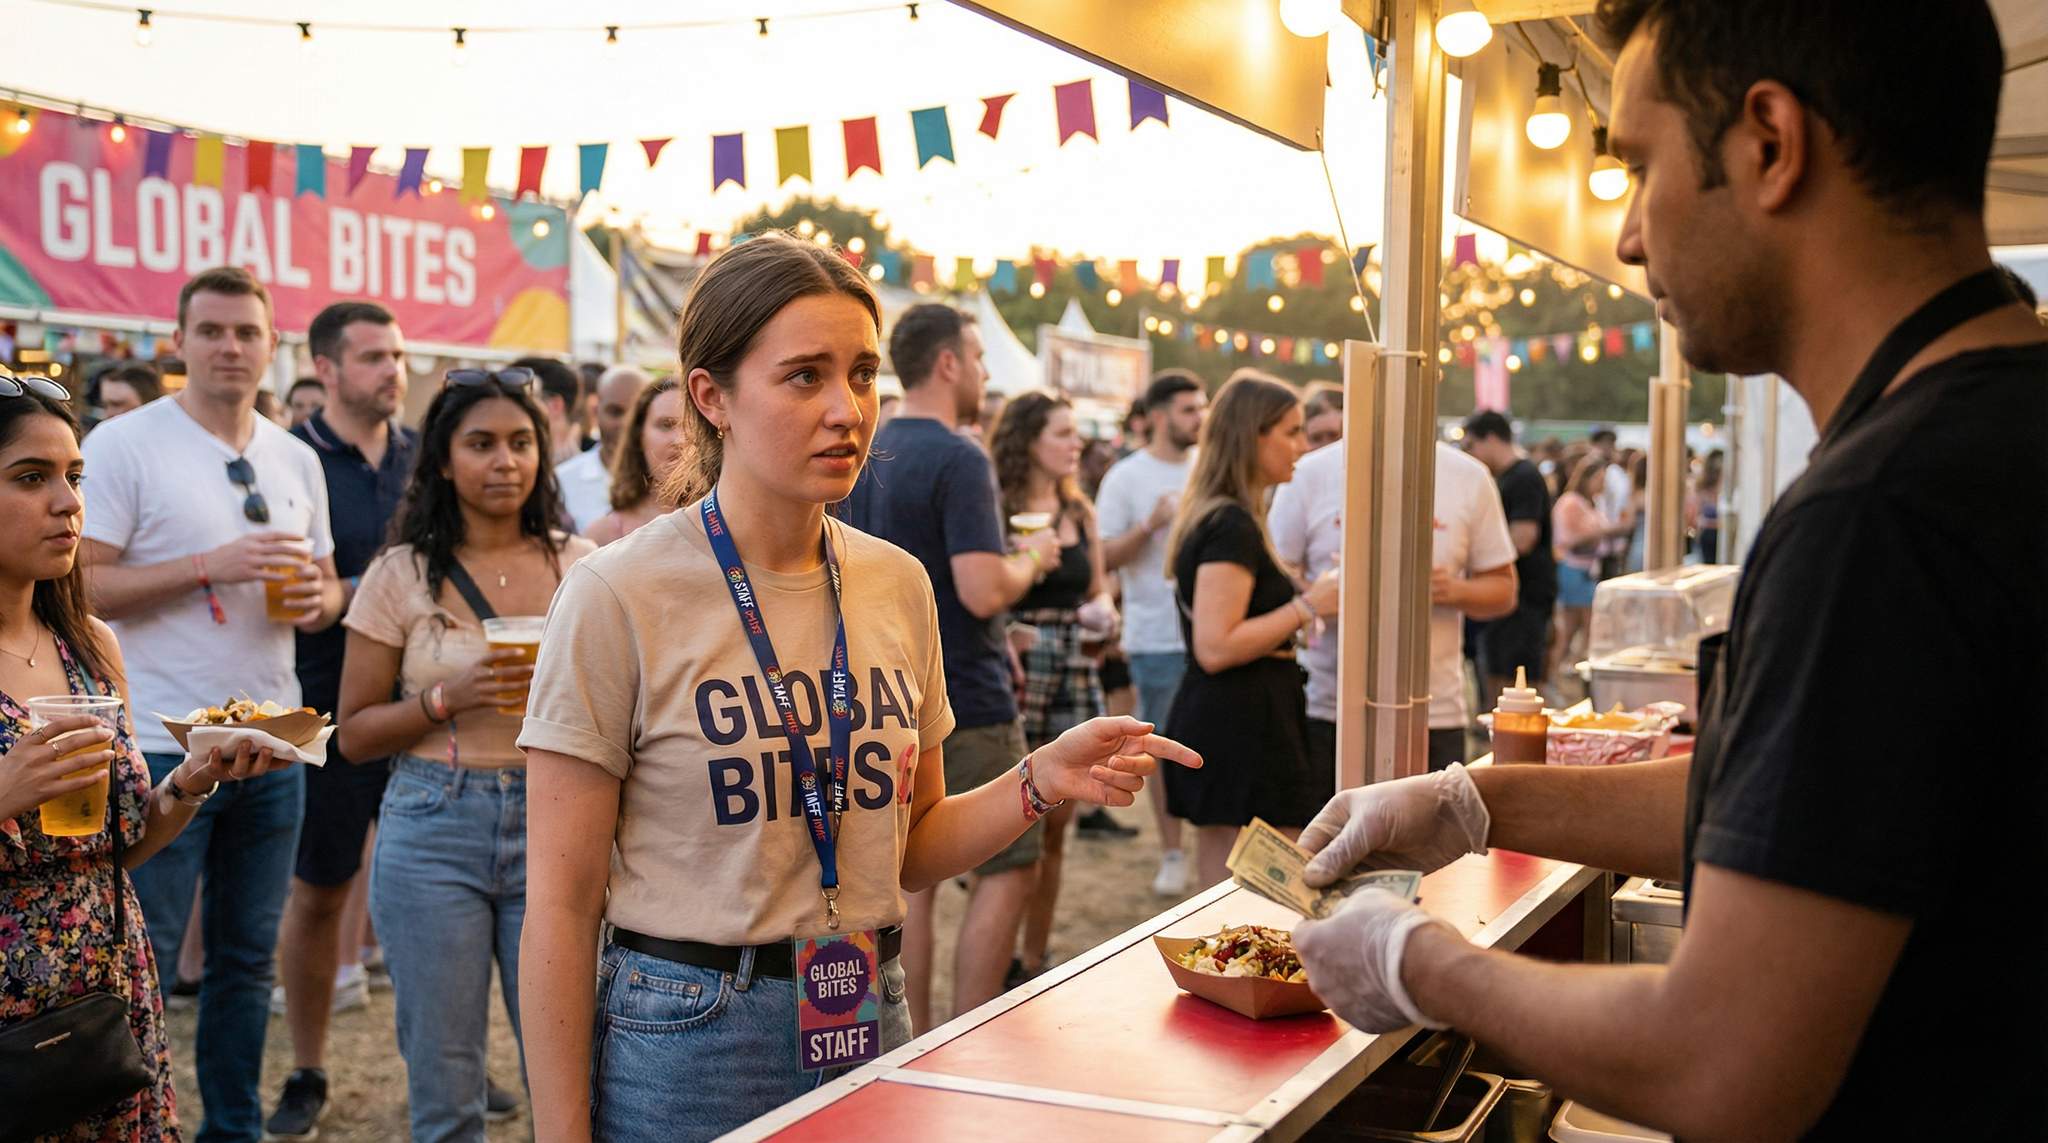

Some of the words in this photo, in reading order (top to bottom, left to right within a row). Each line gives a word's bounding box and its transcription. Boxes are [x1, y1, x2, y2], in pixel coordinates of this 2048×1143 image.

[39, 160, 311, 289] GLOBAL
[329, 206, 477, 308] BITES
[734, 582, 754, 608] STAFF
[695, 667, 918, 745] GLOBAL
[810, 958, 864, 982] GLOBAL
[818, 977, 857, 999] BITES
[810, 1026, 870, 1063] STAFF
